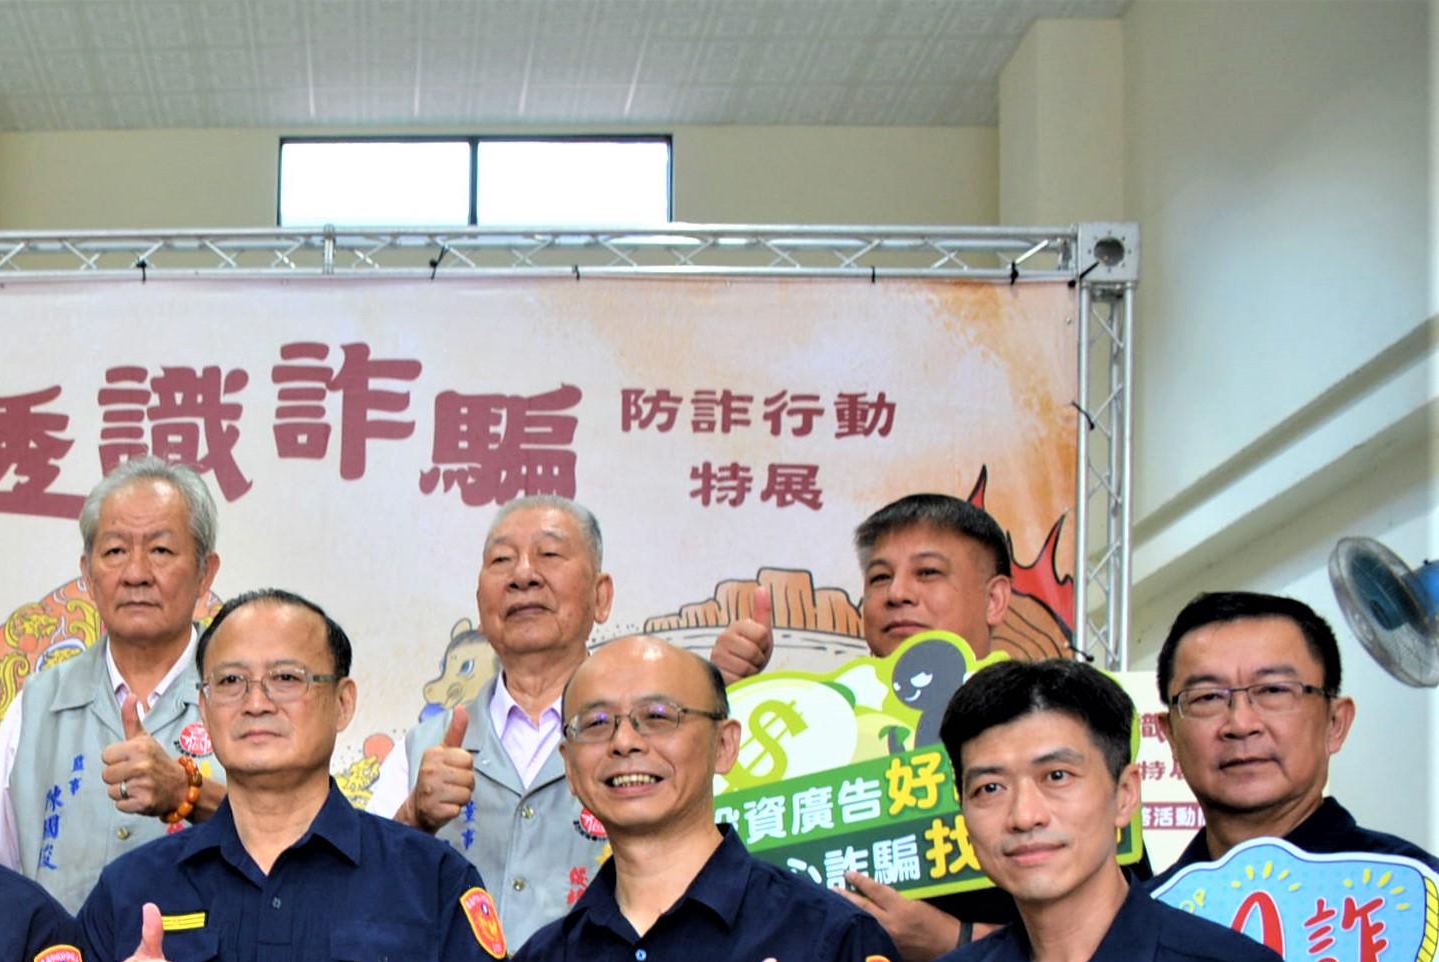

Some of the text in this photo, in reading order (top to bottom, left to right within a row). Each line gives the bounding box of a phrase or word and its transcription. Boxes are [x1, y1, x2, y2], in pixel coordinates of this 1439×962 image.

[620, 387, 898, 438] 防詐行動
[689, 462, 825, 511] 特展
[715, 752, 960, 844] 資廣告好
